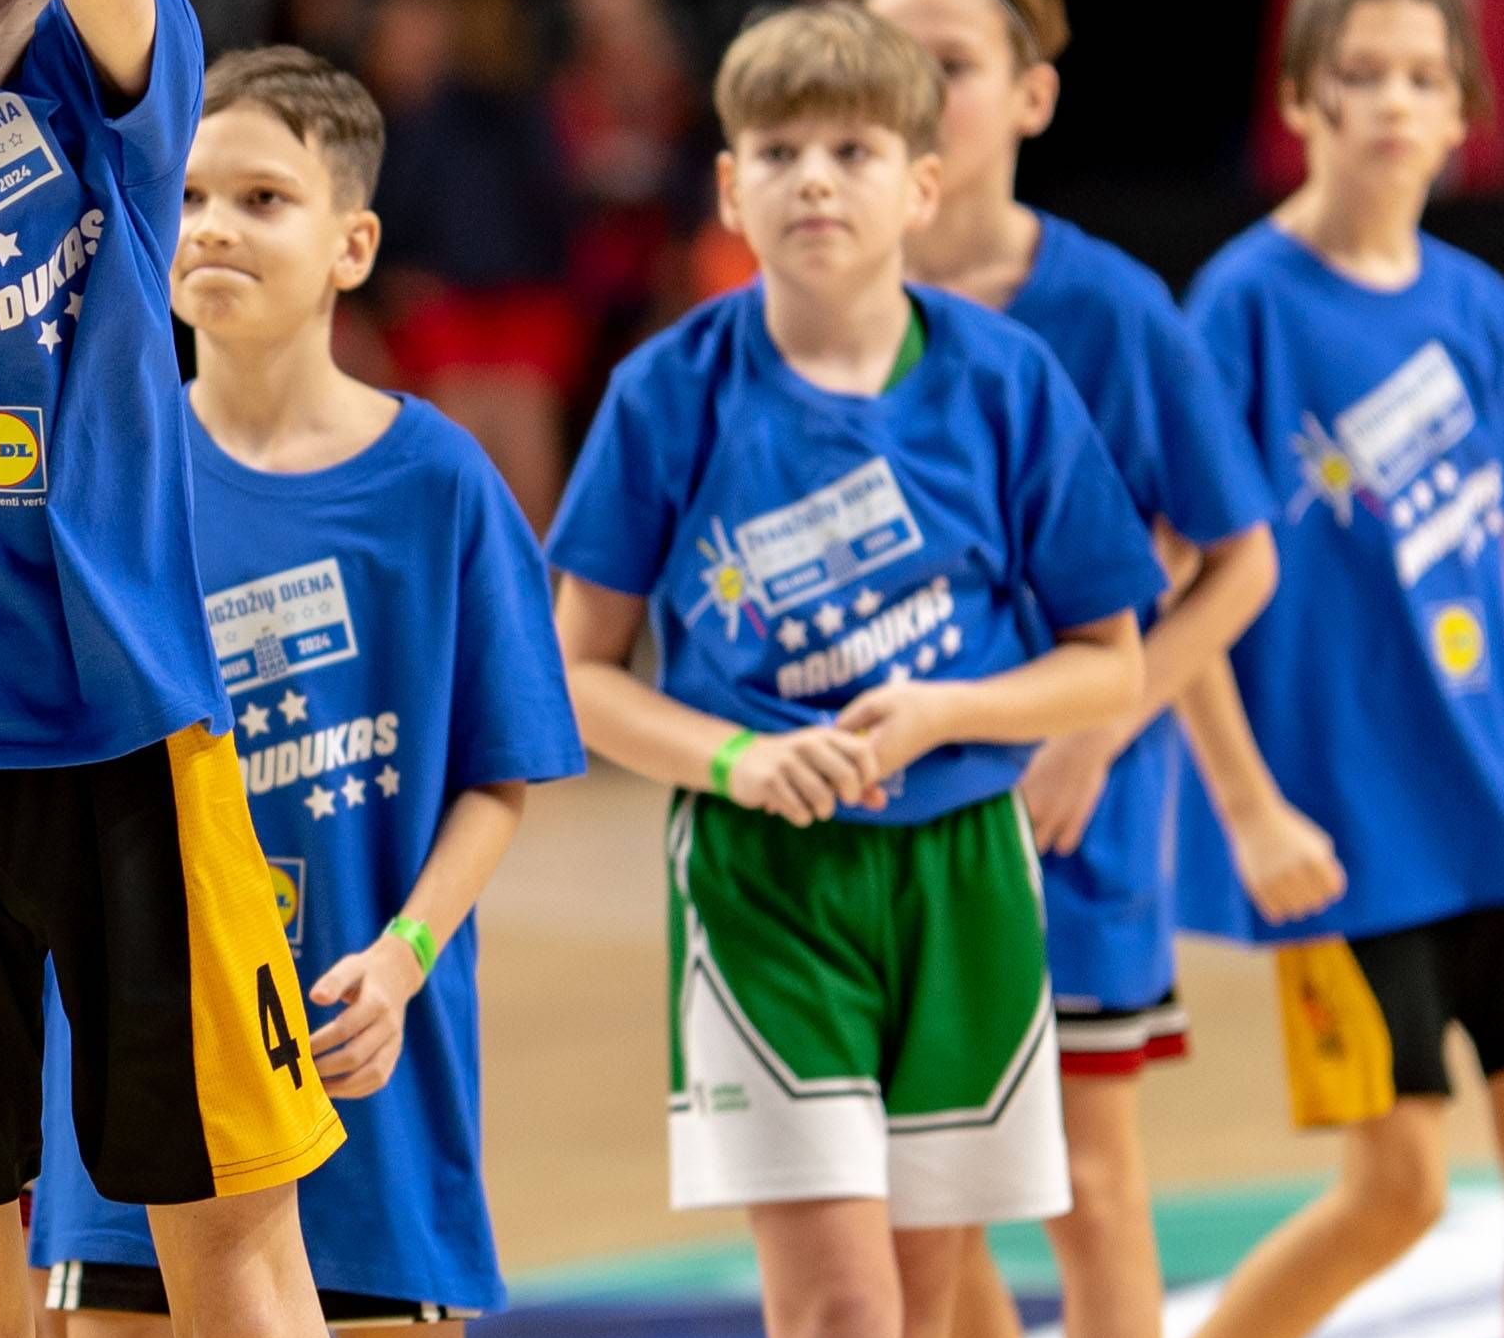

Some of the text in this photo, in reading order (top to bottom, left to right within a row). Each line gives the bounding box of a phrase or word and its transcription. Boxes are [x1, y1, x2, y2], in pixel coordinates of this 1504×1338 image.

[279, 572, 336, 603] DIENA
[296, 633, 333, 656] 2024
[256, 962, 303, 1091] 4
